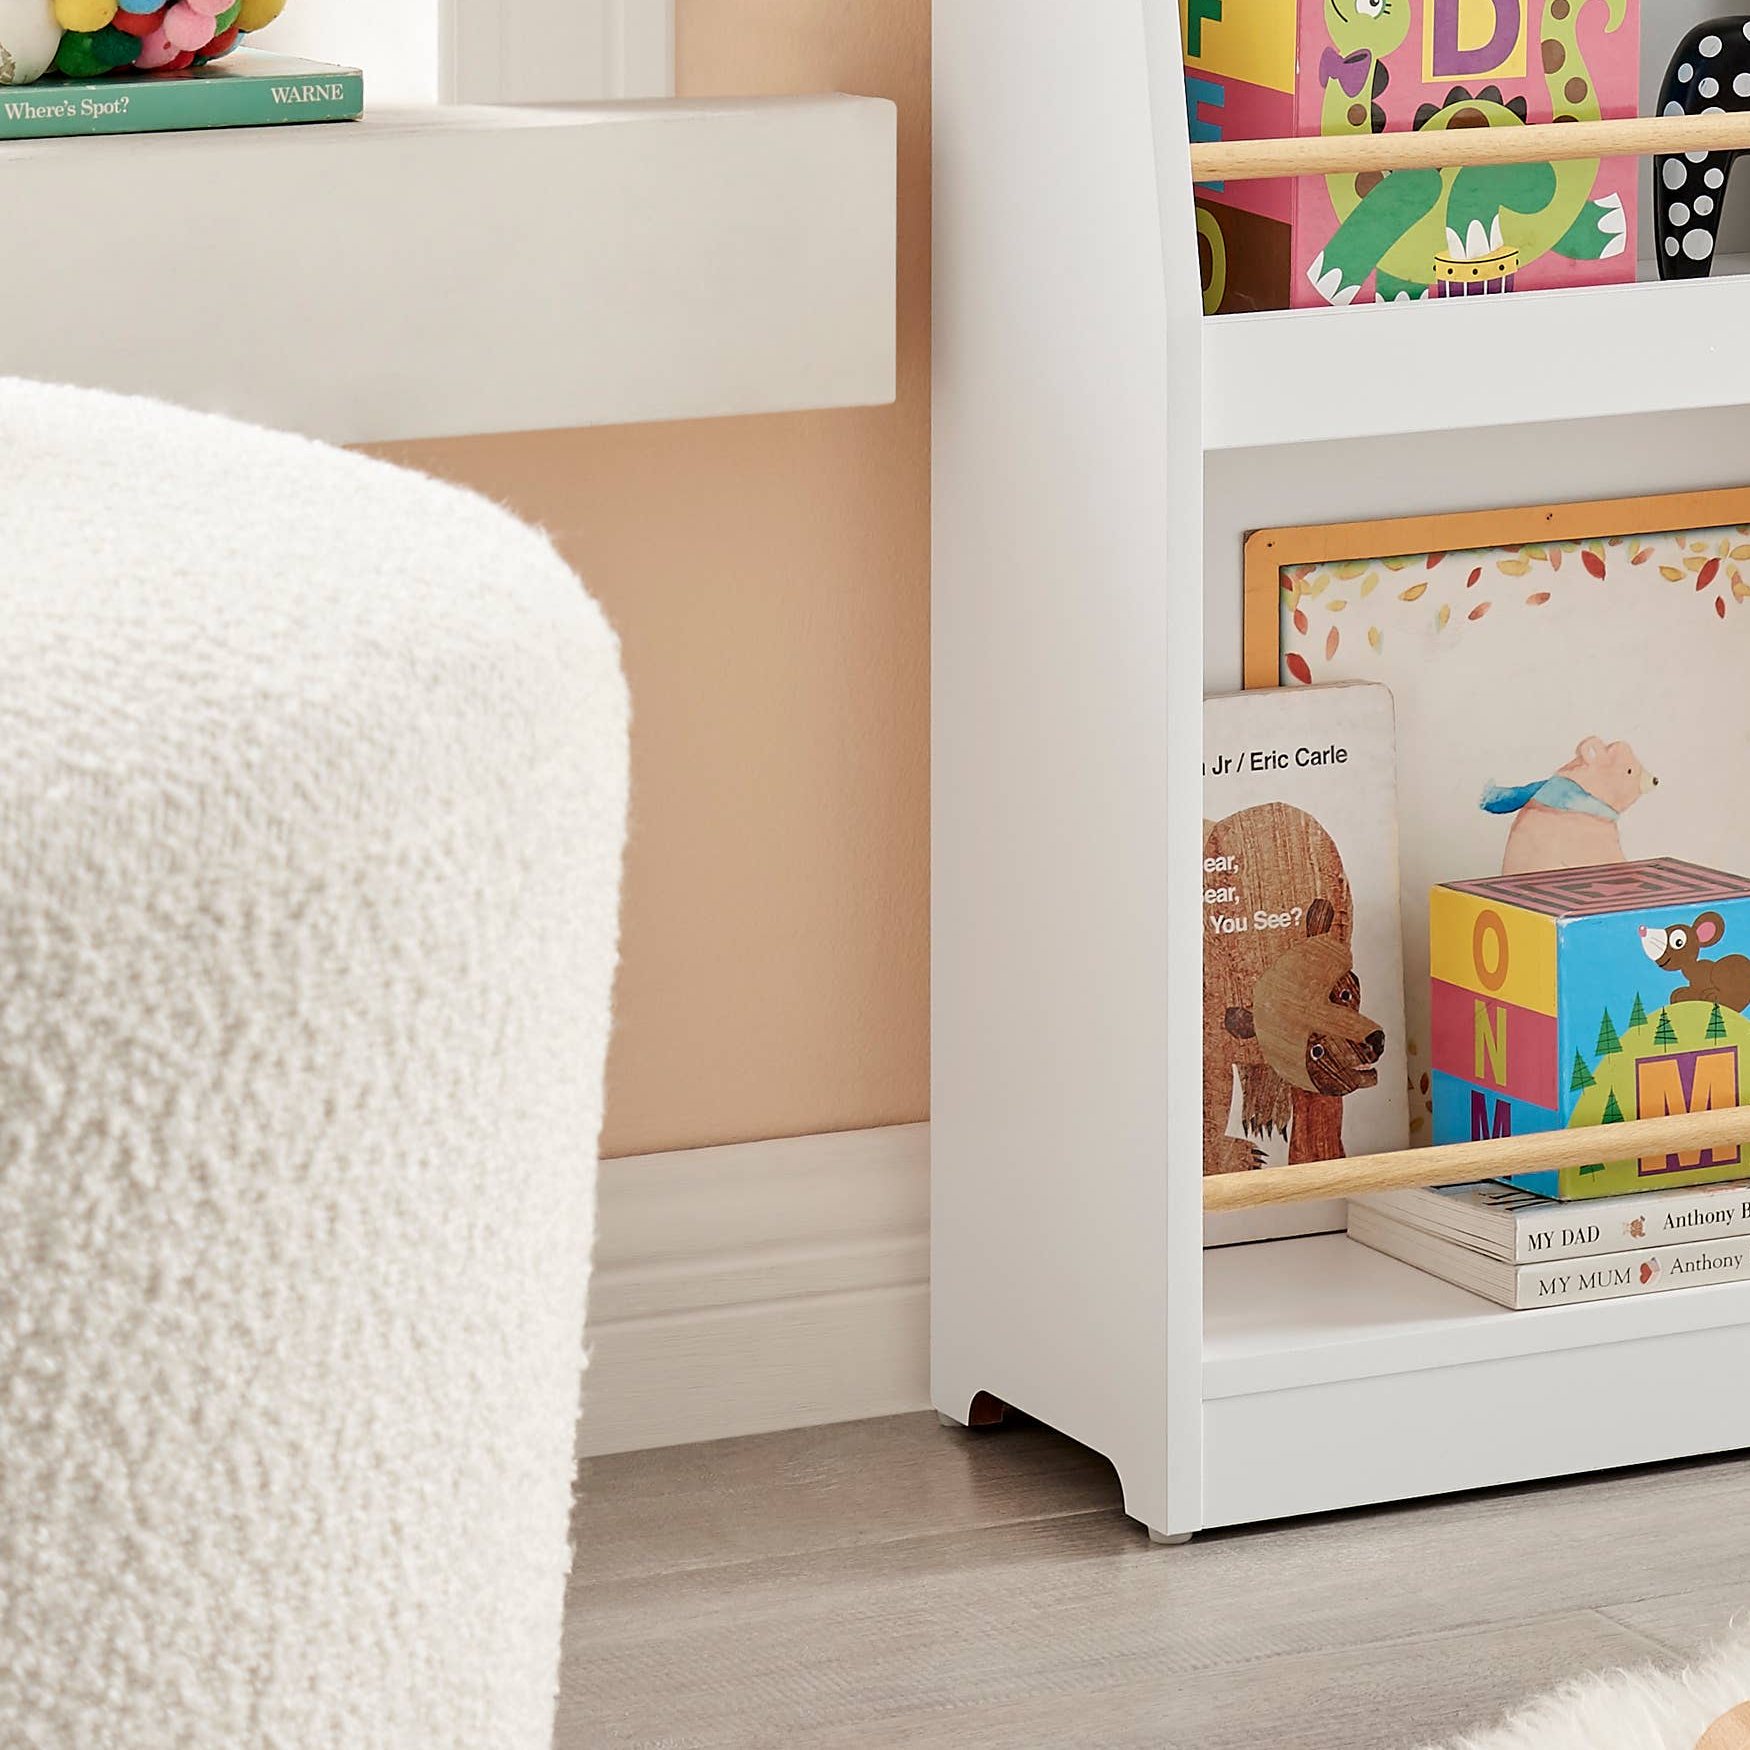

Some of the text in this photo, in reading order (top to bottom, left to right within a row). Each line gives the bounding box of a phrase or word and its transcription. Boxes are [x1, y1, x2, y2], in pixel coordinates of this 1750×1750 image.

[5, 83, 345, 121] Where's Spot? WARNE
[1212, 755, 1233, 776] Jr
[1250, 749, 1289, 772] Eric
[1295, 744, 1349, 768] Carle
[1203, 854, 1240, 875] ear,
[1203, 885, 1241, 906] ear,
[1209, 906, 1304, 934] You See?
[1472, 908, 1510, 992] O
[1473, 998, 1508, 1088] N
[1526, 1230, 1556, 1253] MY
[1561, 1224, 1601, 1248] DAD
[1663, 1205, 1736, 1231] Anthony
[1538, 1276, 1572, 1298] MY
[1578, 1266, 1633, 1292] MUM
[1670, 1252, 1744, 1276] Anthony
